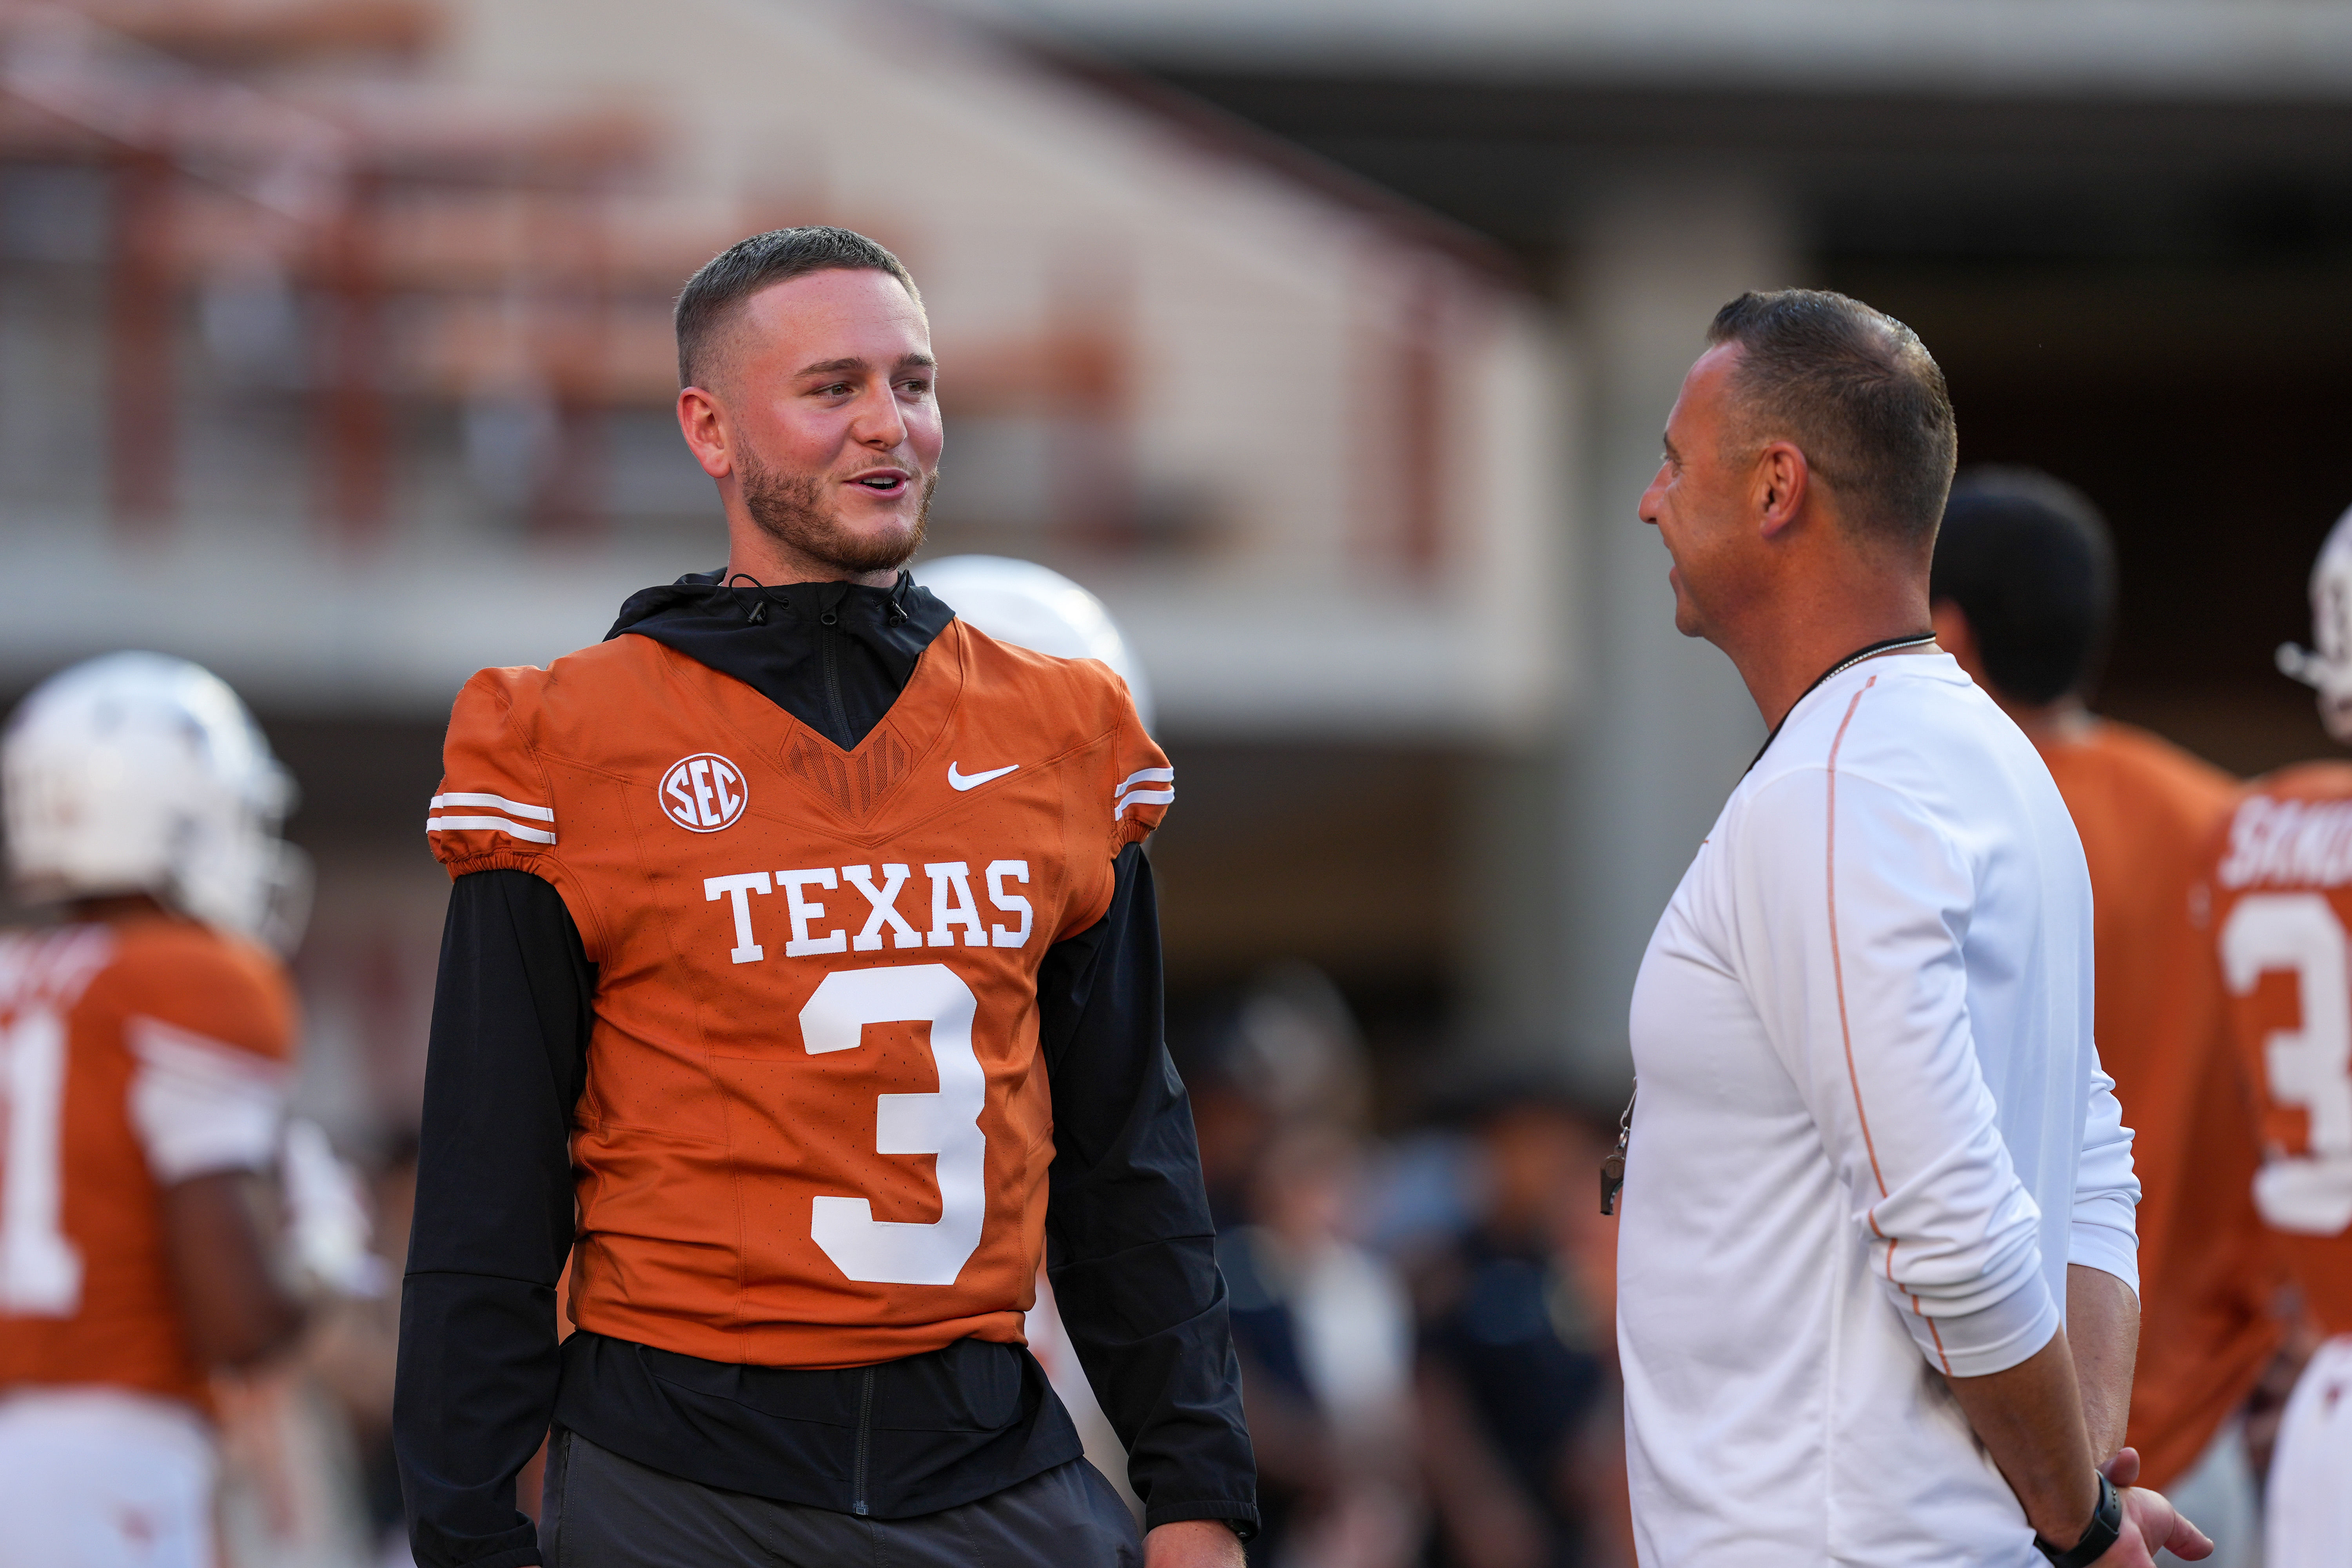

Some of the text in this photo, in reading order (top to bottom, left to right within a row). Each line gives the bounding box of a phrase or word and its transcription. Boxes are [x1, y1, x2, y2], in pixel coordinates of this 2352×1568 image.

[666, 759, 740, 826] SEC
[704, 860, 1034, 964] TEXAS
[799, 963, 986, 1285] 3
